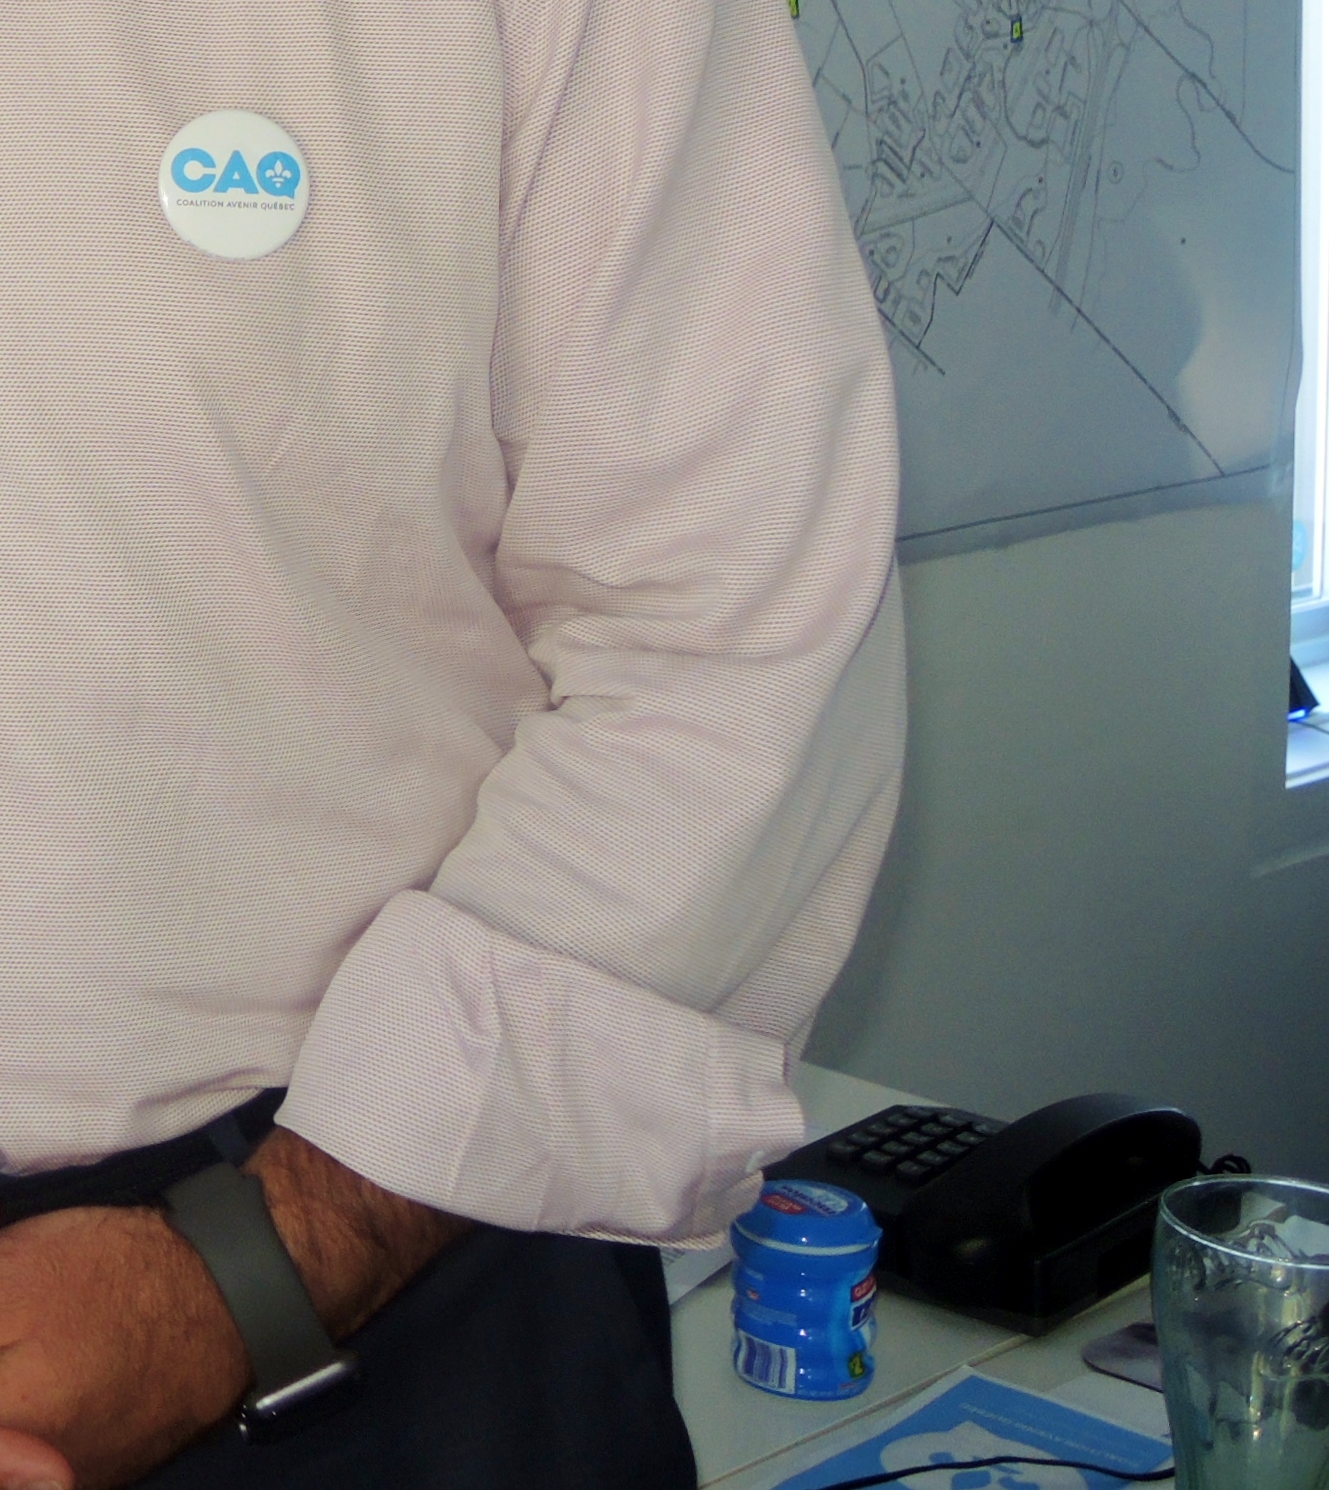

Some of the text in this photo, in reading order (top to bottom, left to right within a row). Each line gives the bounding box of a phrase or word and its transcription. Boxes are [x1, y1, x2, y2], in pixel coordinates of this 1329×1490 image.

[171, 148, 301, 200] CAQ
[176, 199, 295, 210] COALITION AVENIR QUÉBEC
